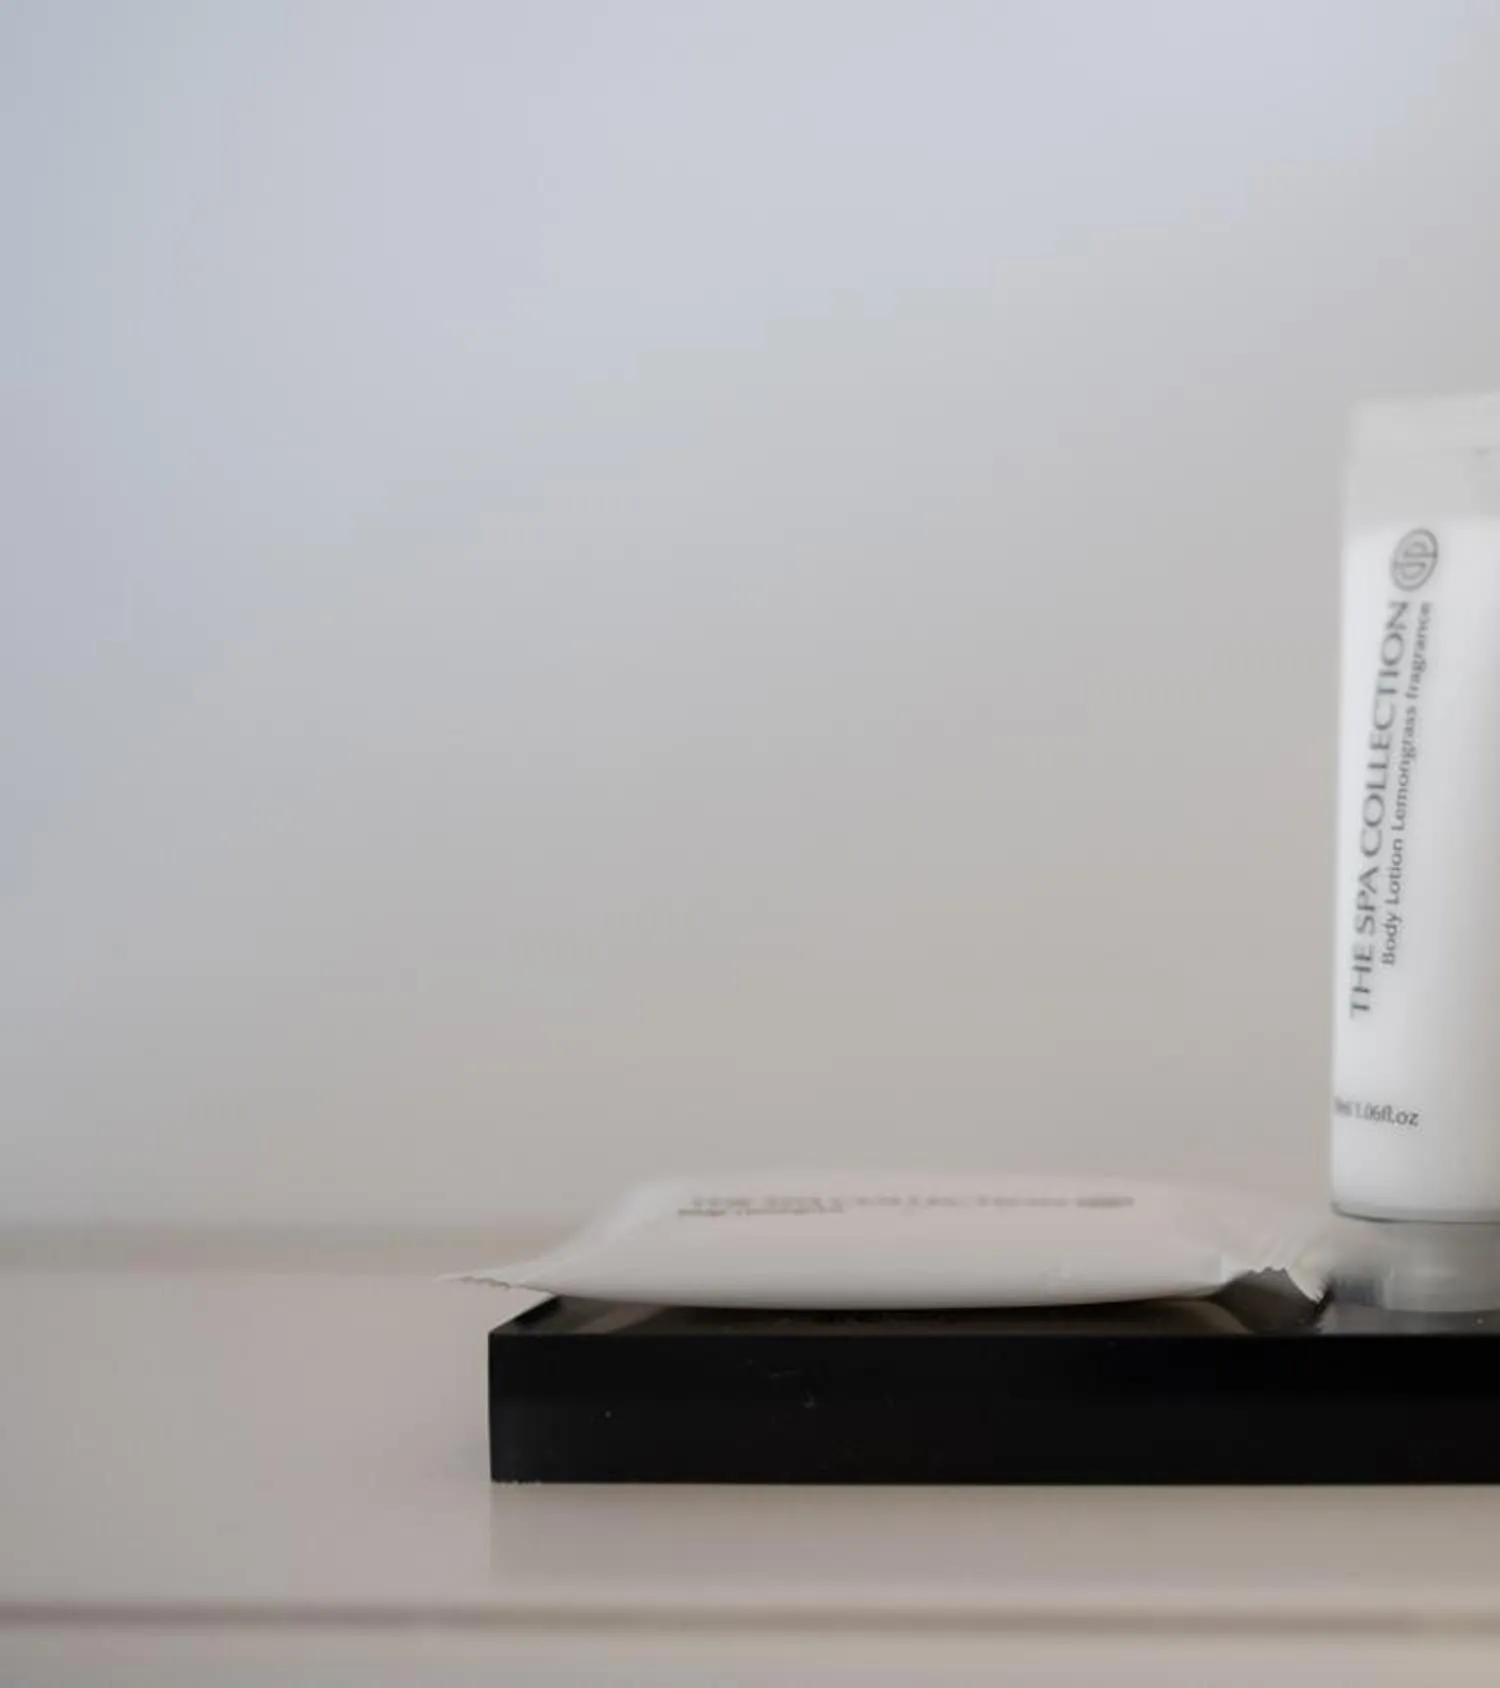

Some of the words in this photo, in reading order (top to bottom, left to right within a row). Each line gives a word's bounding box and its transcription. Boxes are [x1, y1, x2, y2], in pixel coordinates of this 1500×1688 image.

[1405, 602, 1431, 700] fragrance
[1361, 601, 1408, 857] COLLECTION
[1391, 706, 1417, 831] Lemongrass
[1355, 866, 1379, 935] SPA
[1384, 838, 1404, 905] Lotion
[1381, 912, 1402, 966] Body
[1350, 942, 1374, 1019] THE
